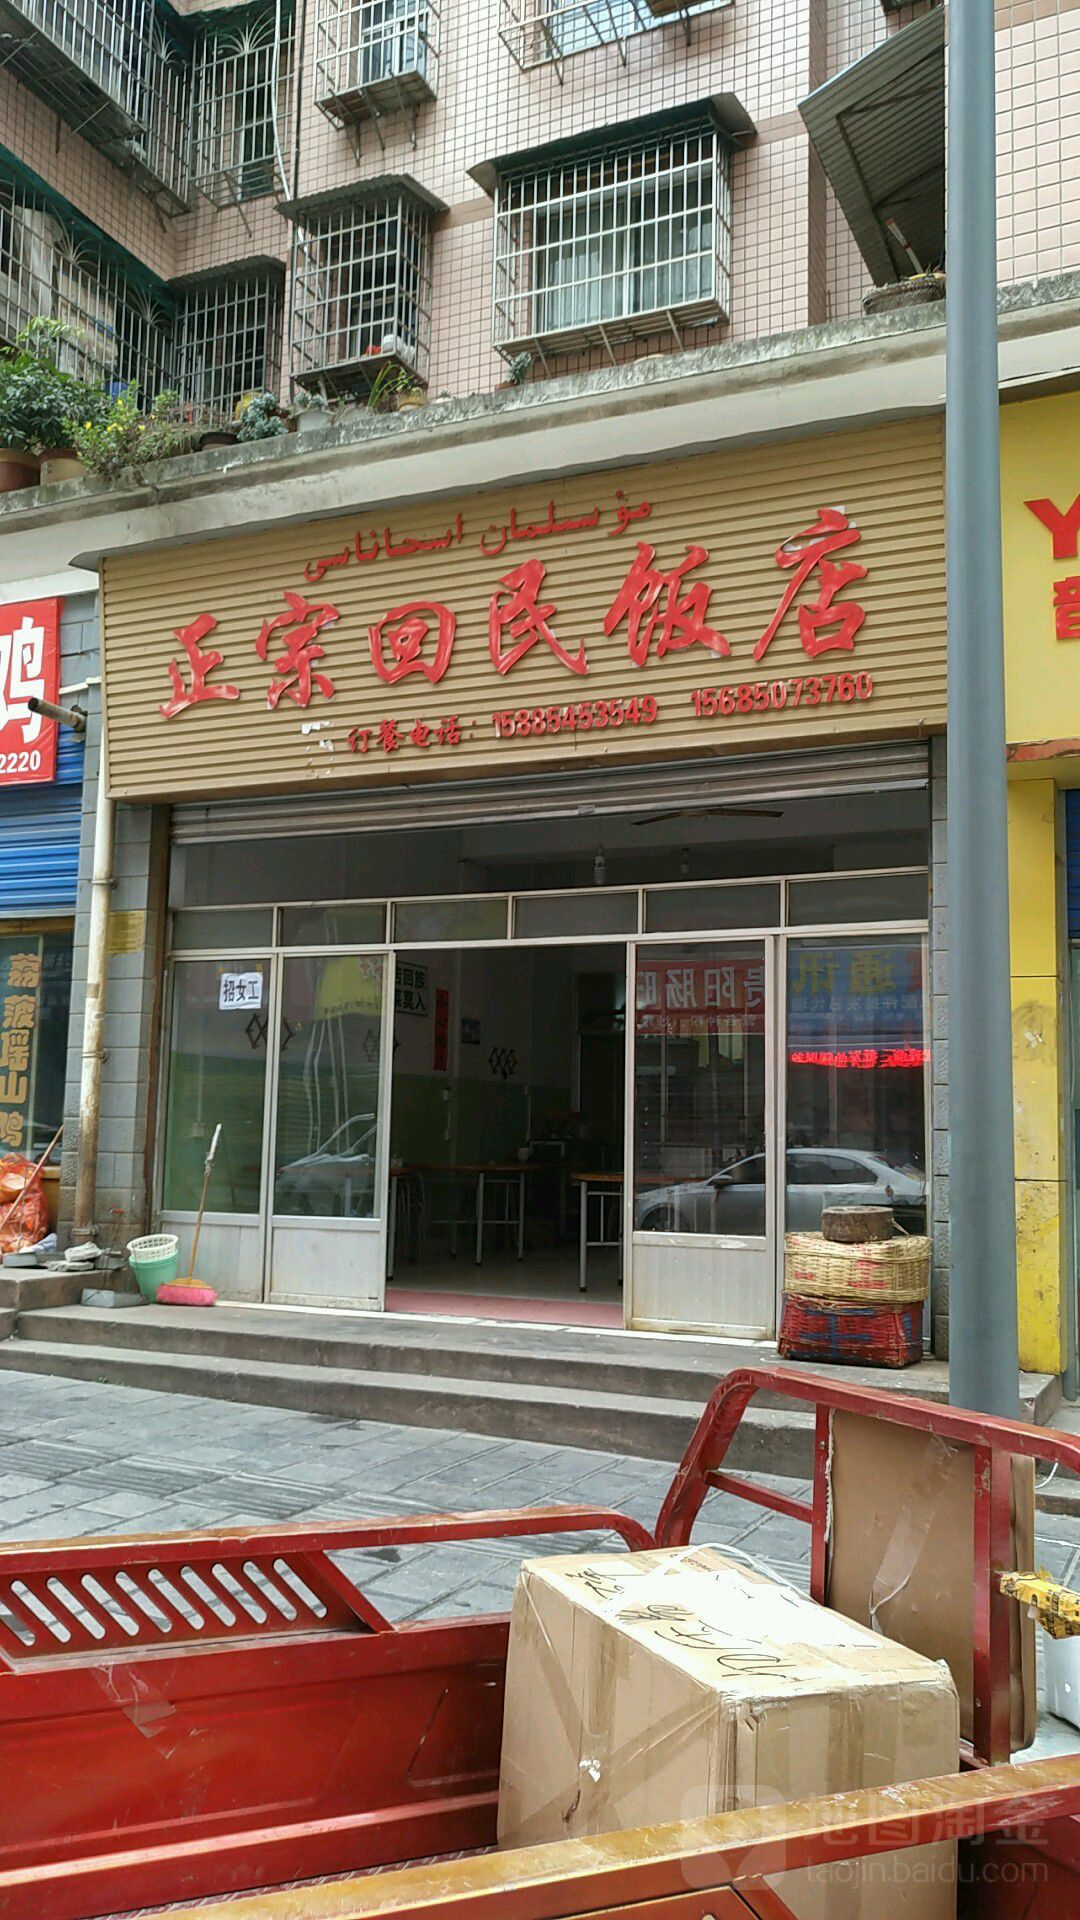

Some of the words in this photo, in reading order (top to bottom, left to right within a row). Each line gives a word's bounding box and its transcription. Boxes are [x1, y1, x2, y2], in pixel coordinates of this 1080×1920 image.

[160, 509, 868, 719] 正宗回民饭店
[492, 694, 658, 738] 15885453549
[690, 670, 874, 717] 15685073760
[223, 978, 260, 1003] 招女工
